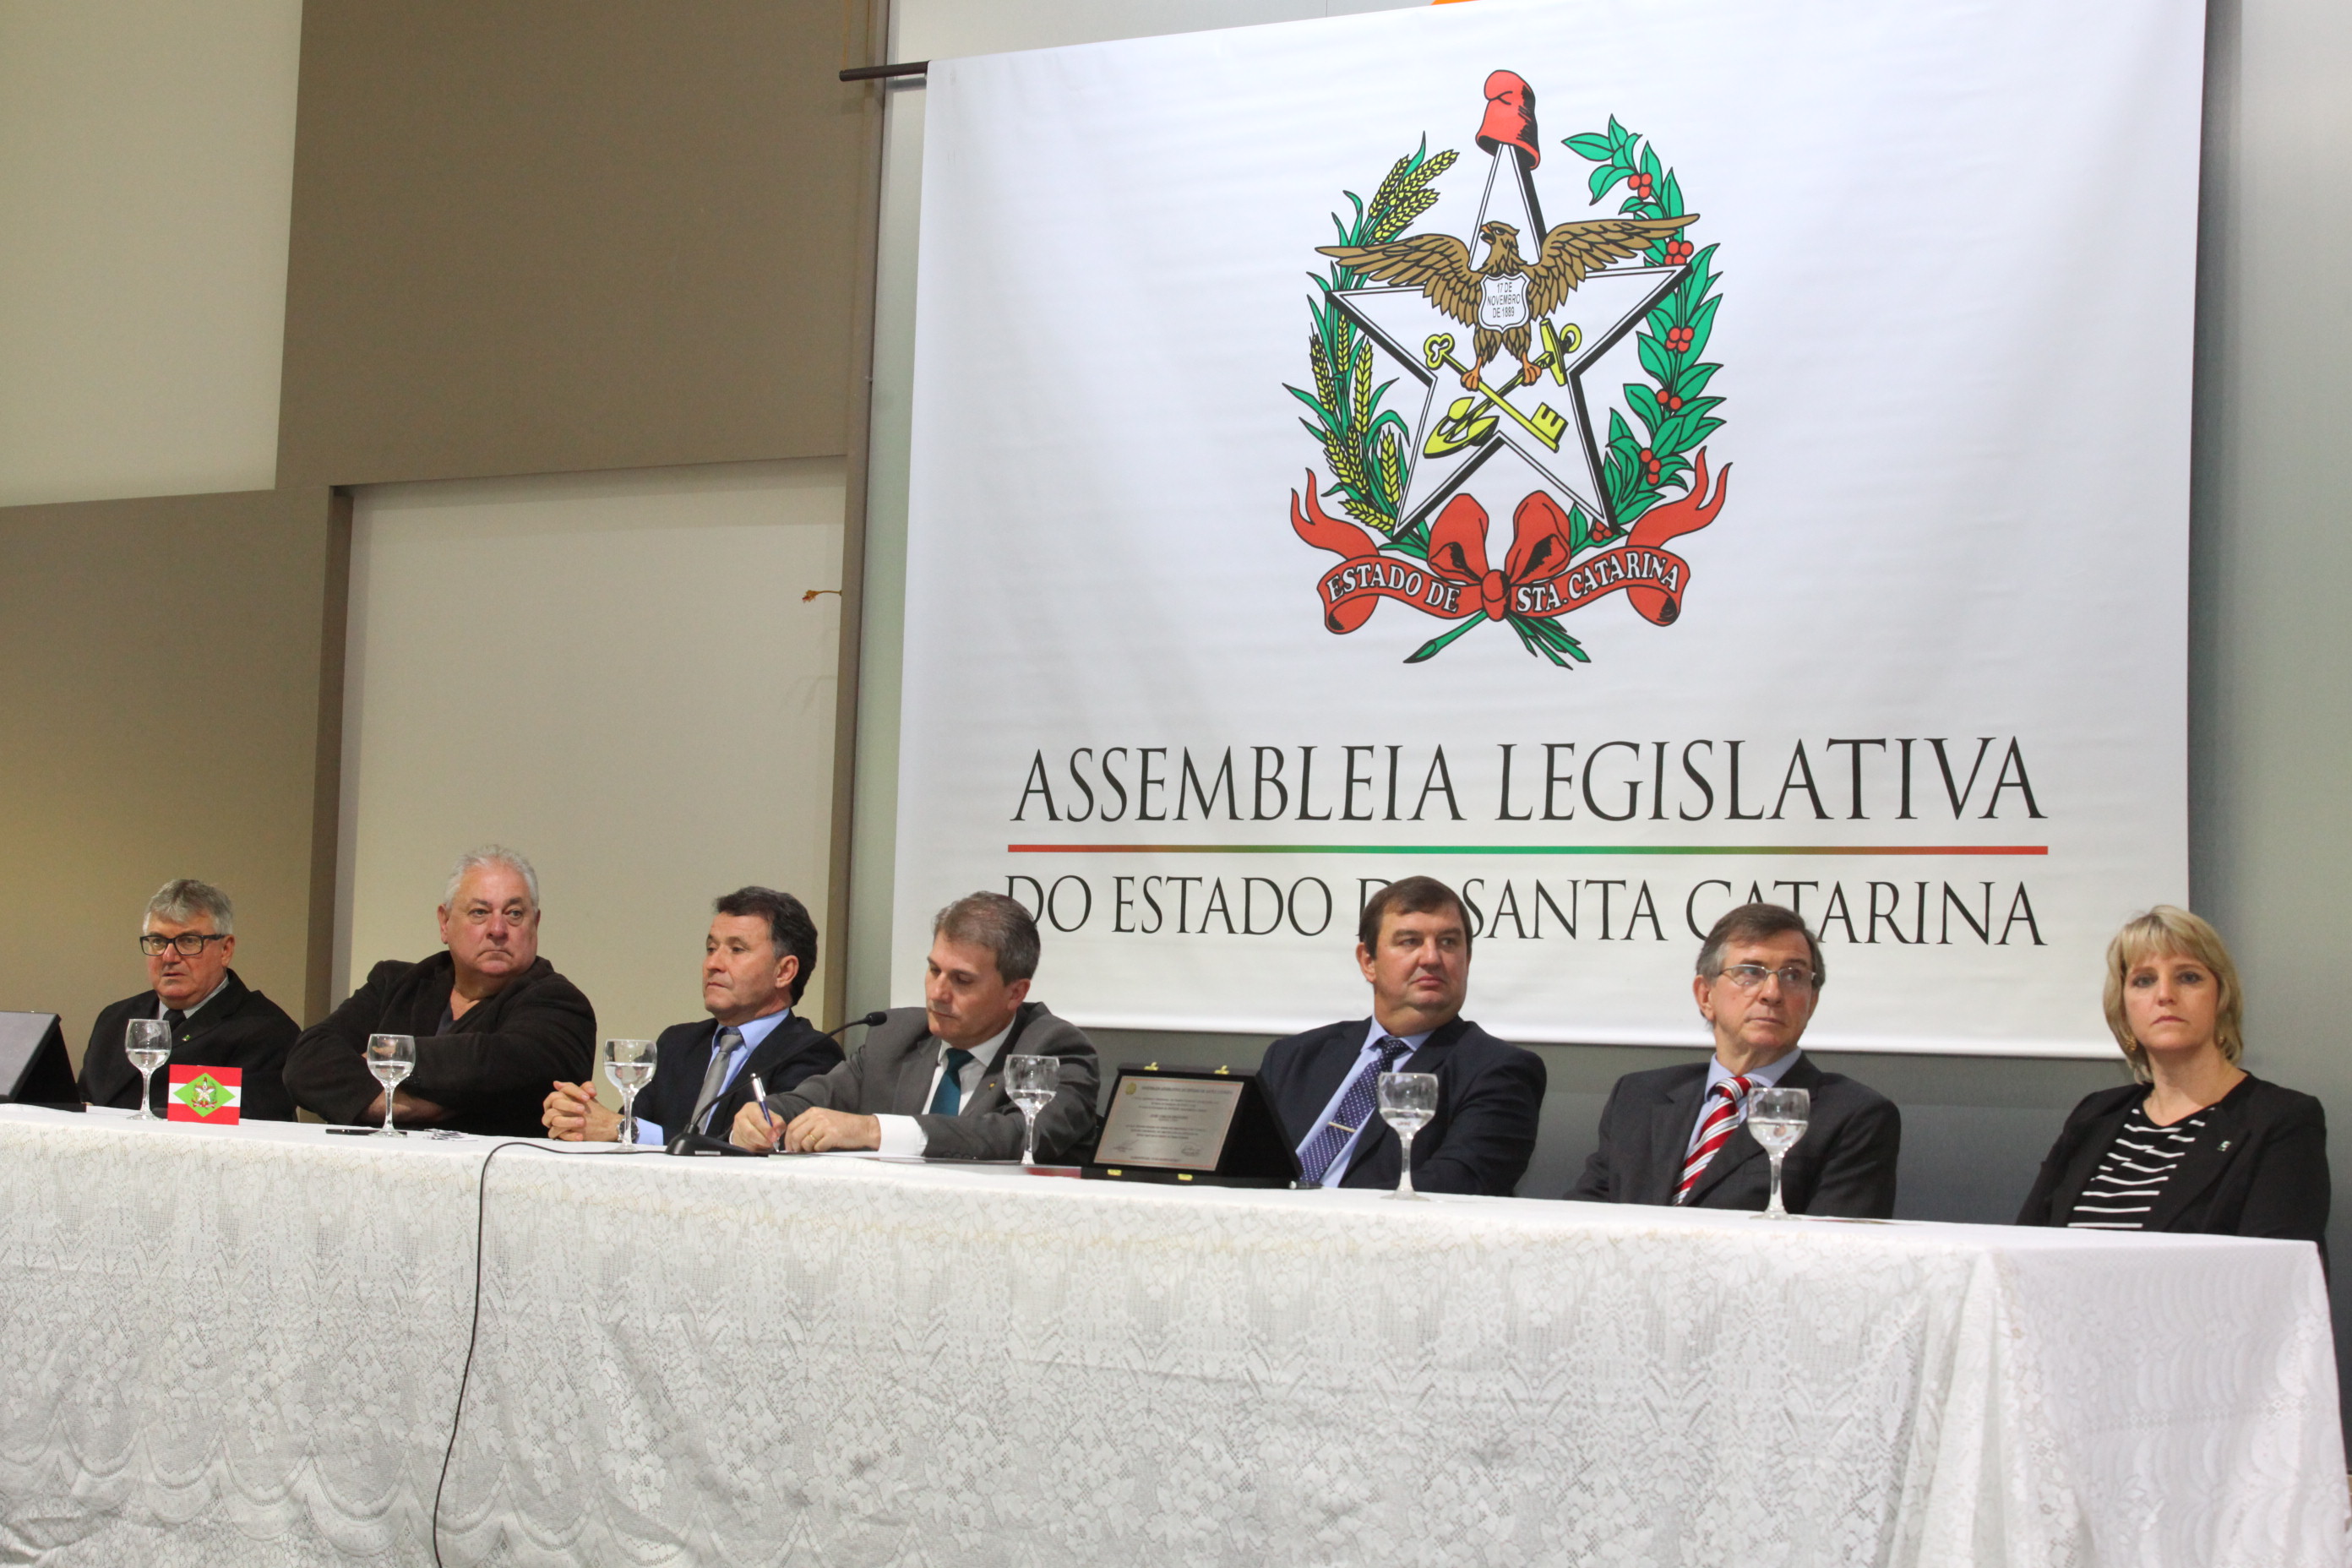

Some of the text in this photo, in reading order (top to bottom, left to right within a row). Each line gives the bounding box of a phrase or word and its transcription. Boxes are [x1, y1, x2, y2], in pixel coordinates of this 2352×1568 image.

[1487, 294, 1521, 306] NOVEMBRO
[1497, 282, 1513, 293] 17 DE
[1493, 307, 1515, 318] DE 1889
[1326, 563, 1423, 603] ESTADO
[1425, 582, 1461, 613] DE
[1567, 552, 1680, 601] CATARINA
[1010, 736, 2049, 822] ASSEMBLEIA LEGISLATIVA
[1004, 874, 1092, 933] DO
[1113, 876, 1331, 936] ESTADO
[1462, 878, 1669, 941] SANTA
